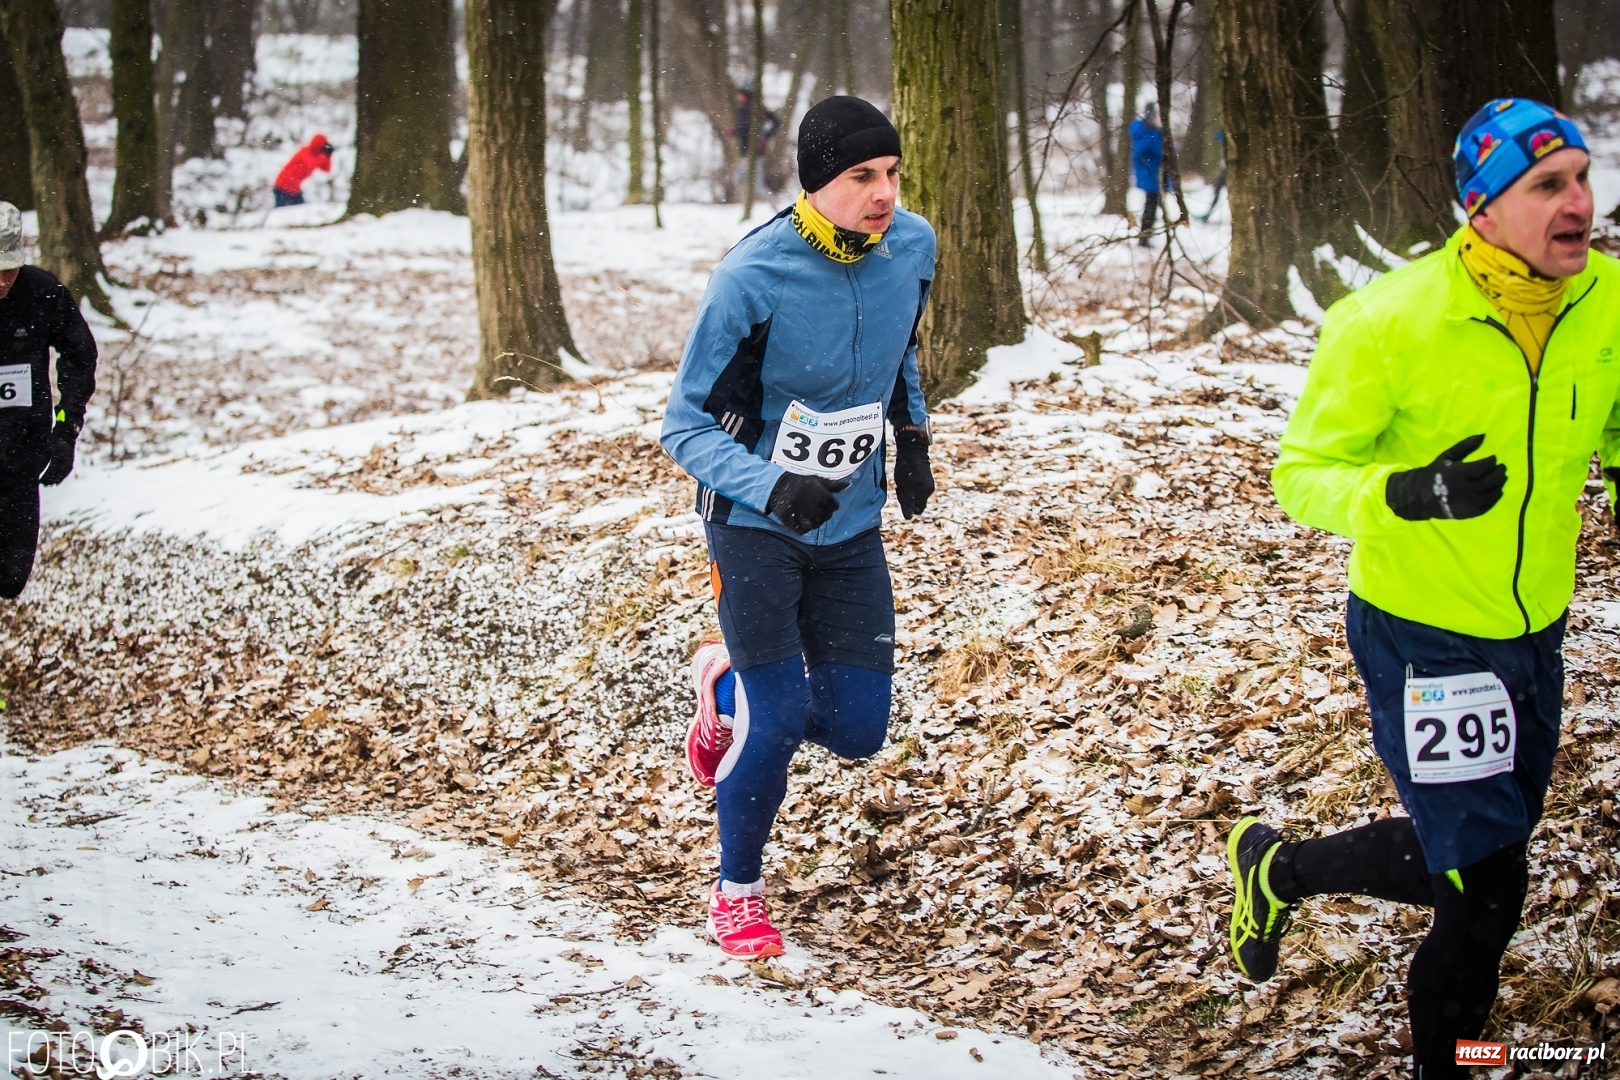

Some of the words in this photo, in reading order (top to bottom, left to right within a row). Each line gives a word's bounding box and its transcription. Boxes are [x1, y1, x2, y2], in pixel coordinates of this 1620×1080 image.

[823, 411, 880, 428] www.personalbest.pl
[781, 431, 876, 469] 368
[1414, 708, 1511, 762] 295
